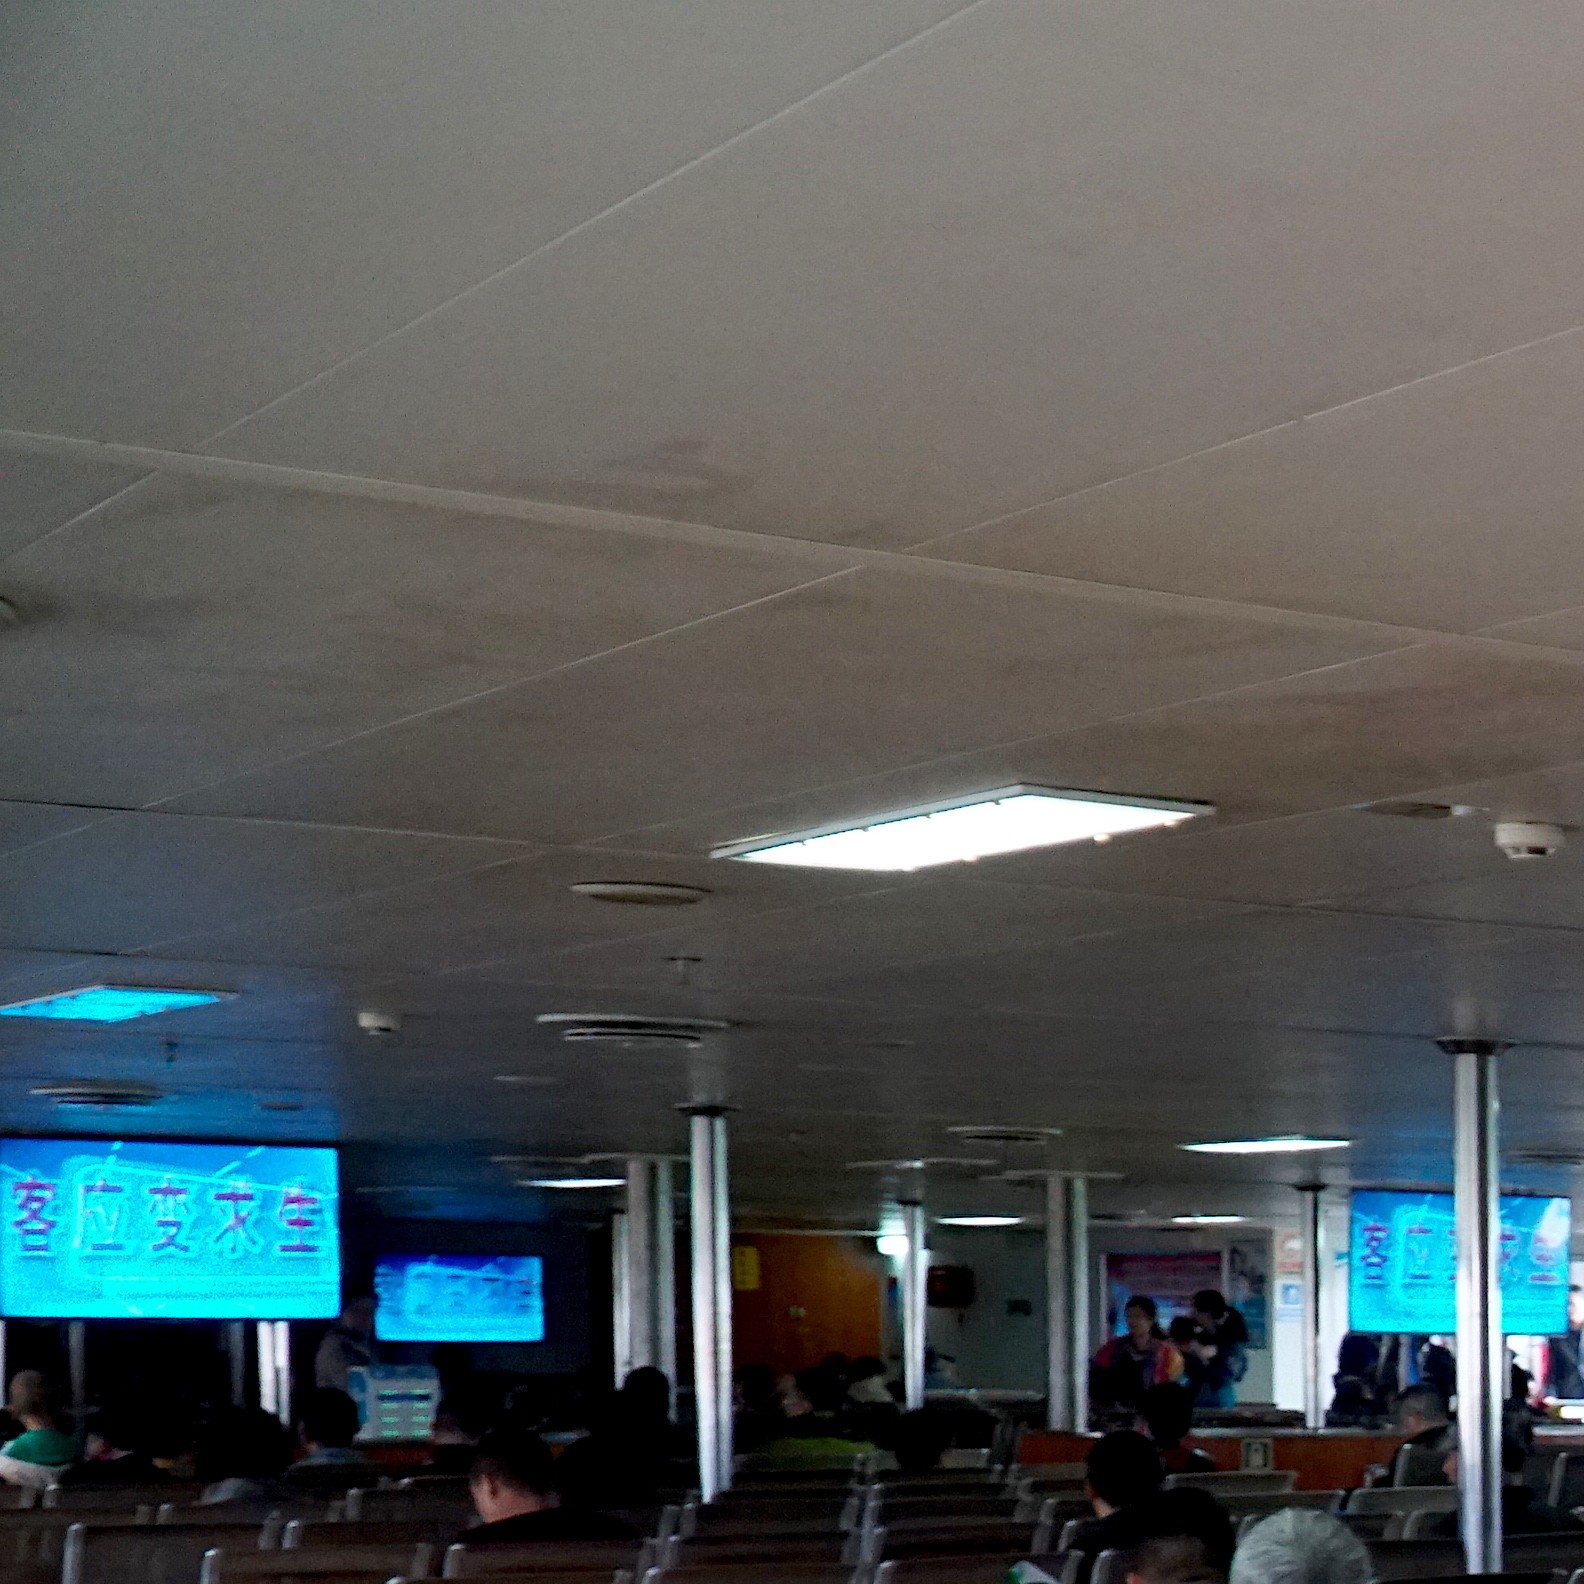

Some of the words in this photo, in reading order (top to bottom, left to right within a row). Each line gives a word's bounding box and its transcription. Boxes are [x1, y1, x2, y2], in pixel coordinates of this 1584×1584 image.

[12, 1173, 323, 1255] 客应变求生
